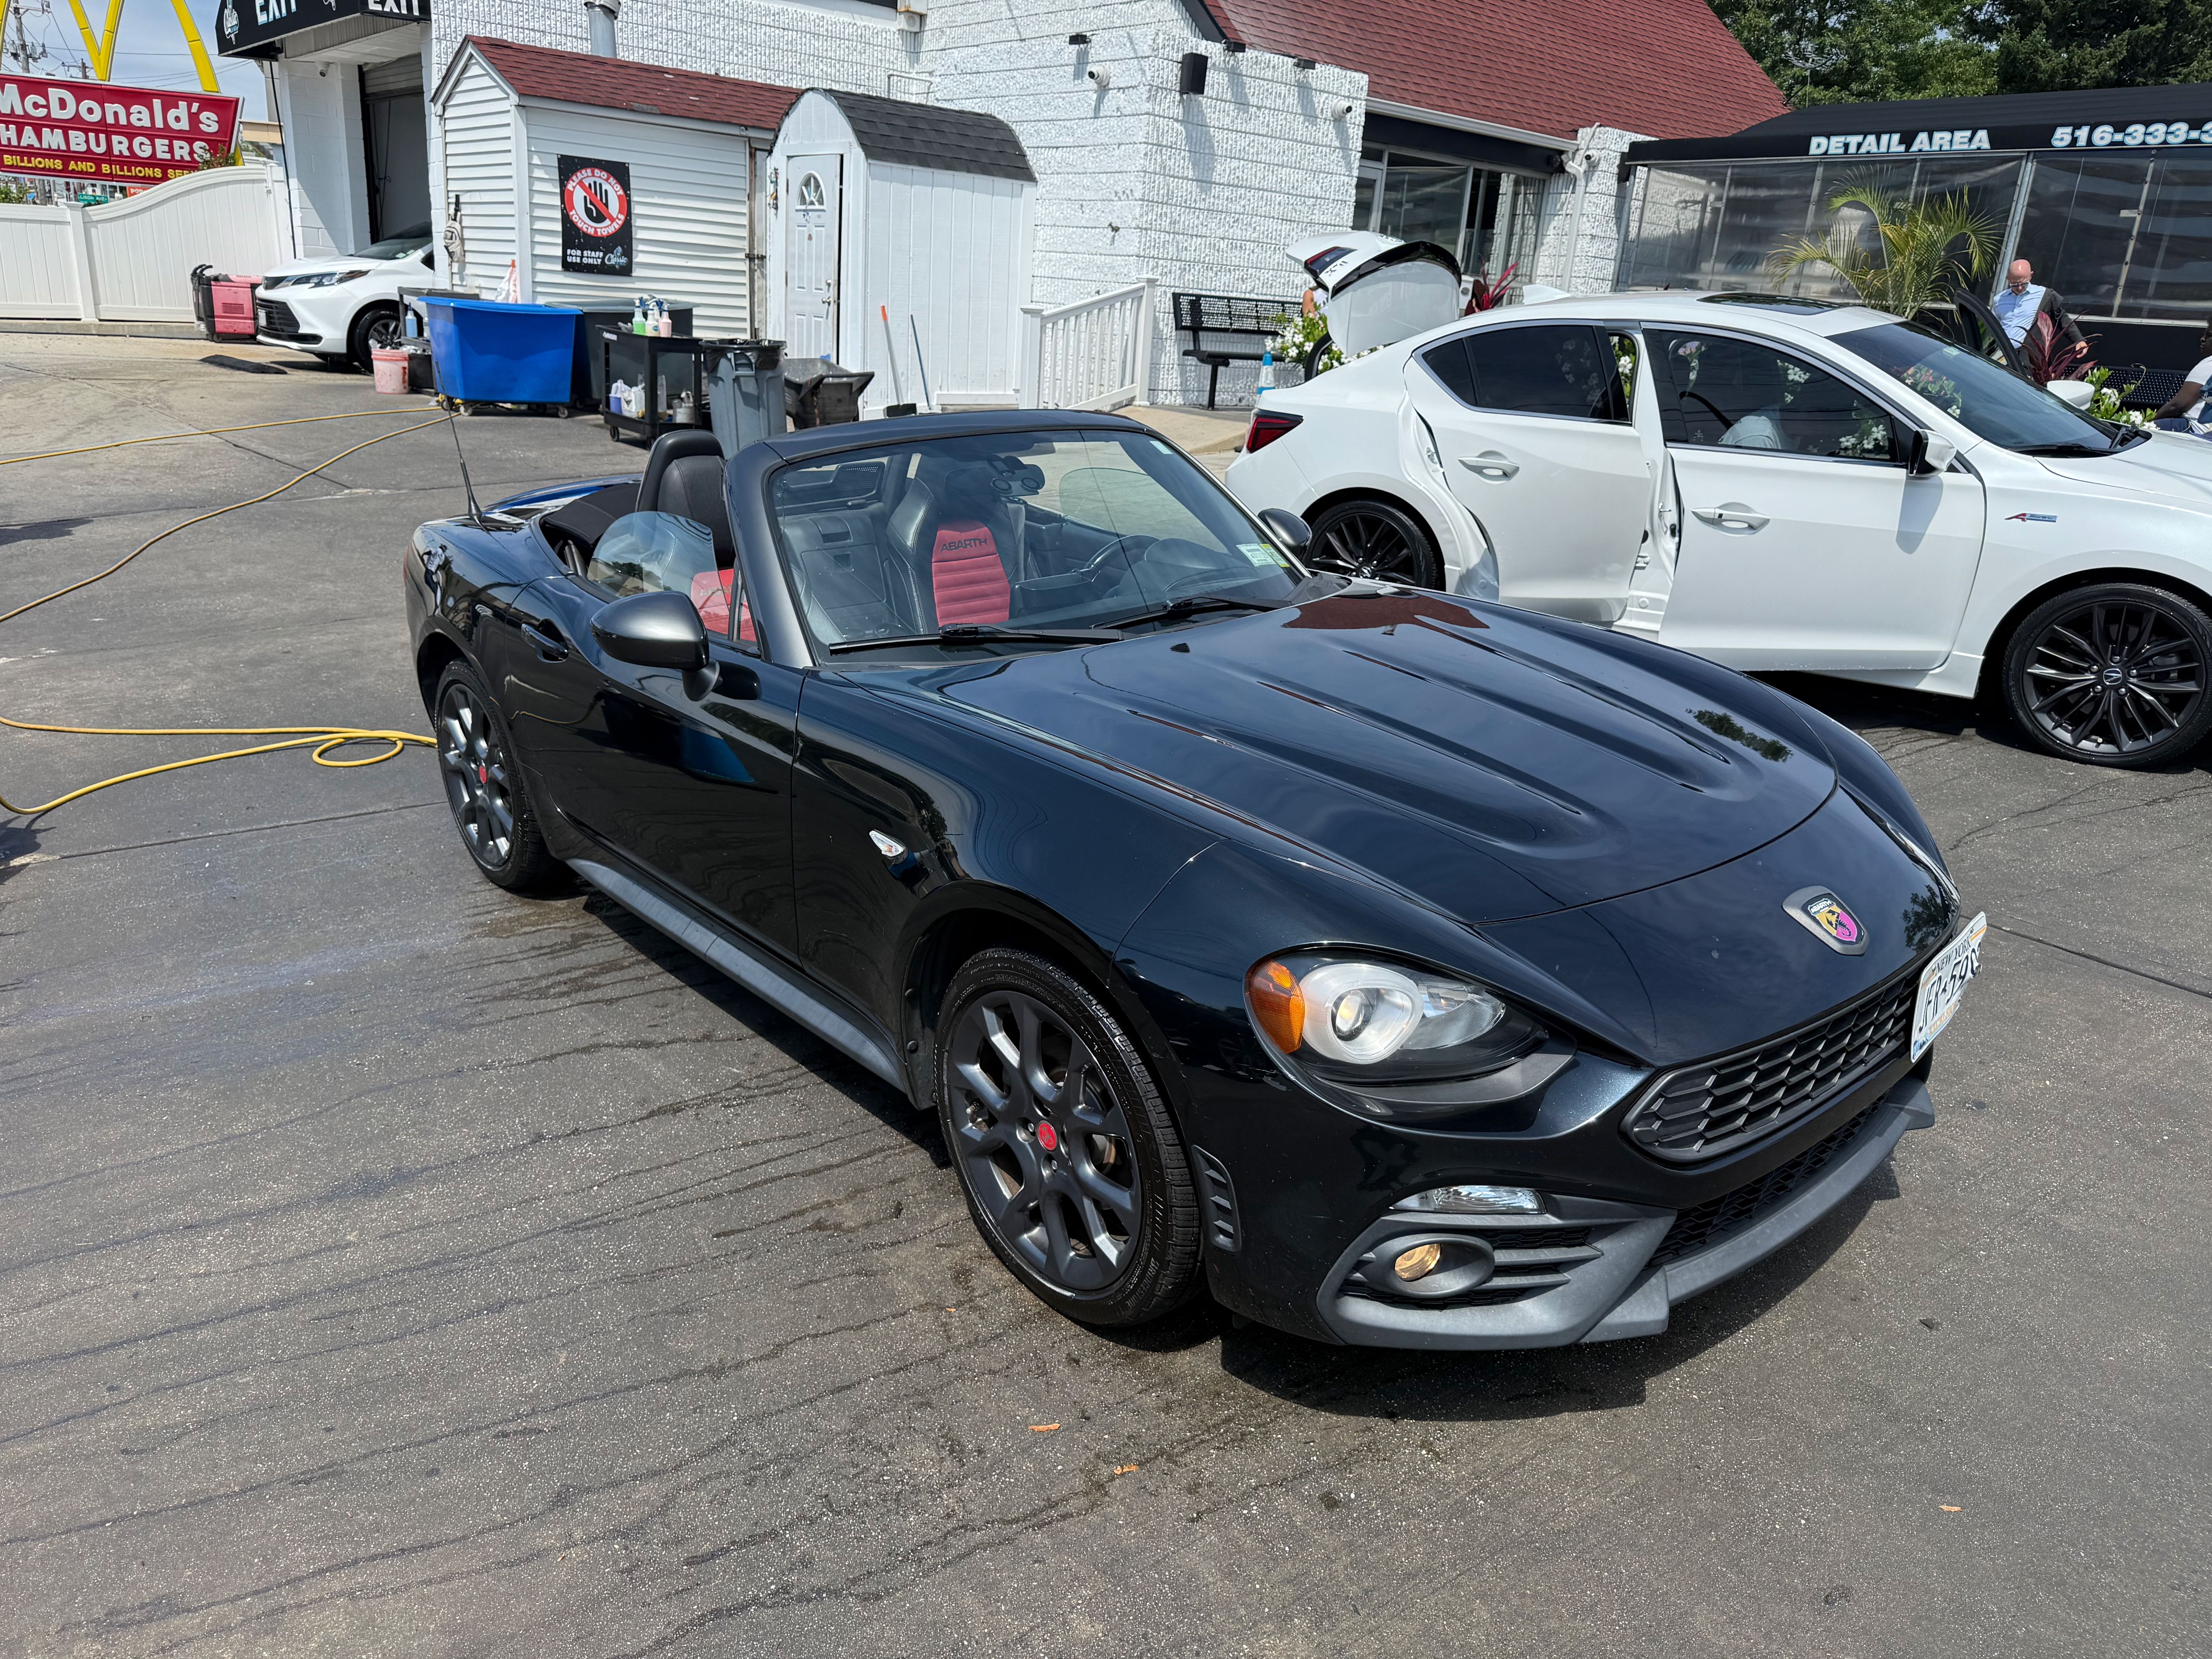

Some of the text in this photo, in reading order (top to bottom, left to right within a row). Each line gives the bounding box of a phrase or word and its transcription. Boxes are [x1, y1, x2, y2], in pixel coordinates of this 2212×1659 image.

[0, 84, 219, 133] McDonald's
[0, 124, 210, 162] HAMBURGERS
[1809, 129, 1991, 155] DETAIL AREA
[3, 155, 63, 170] BILLIONS
[69, 161, 96, 173] AND
[101, 163, 162, 178] BILLIONS
[567, 168, 625, 196] PLEASE DO NOT
[568, 210, 625, 236] TOUCH TOWELS
[605, 253, 628, 265] Classic
[941, 538, 988, 551] ABARTH
[1810, 900, 1833, 914] ABARTH
[1937, 936, 1972, 971] NEW YORK
